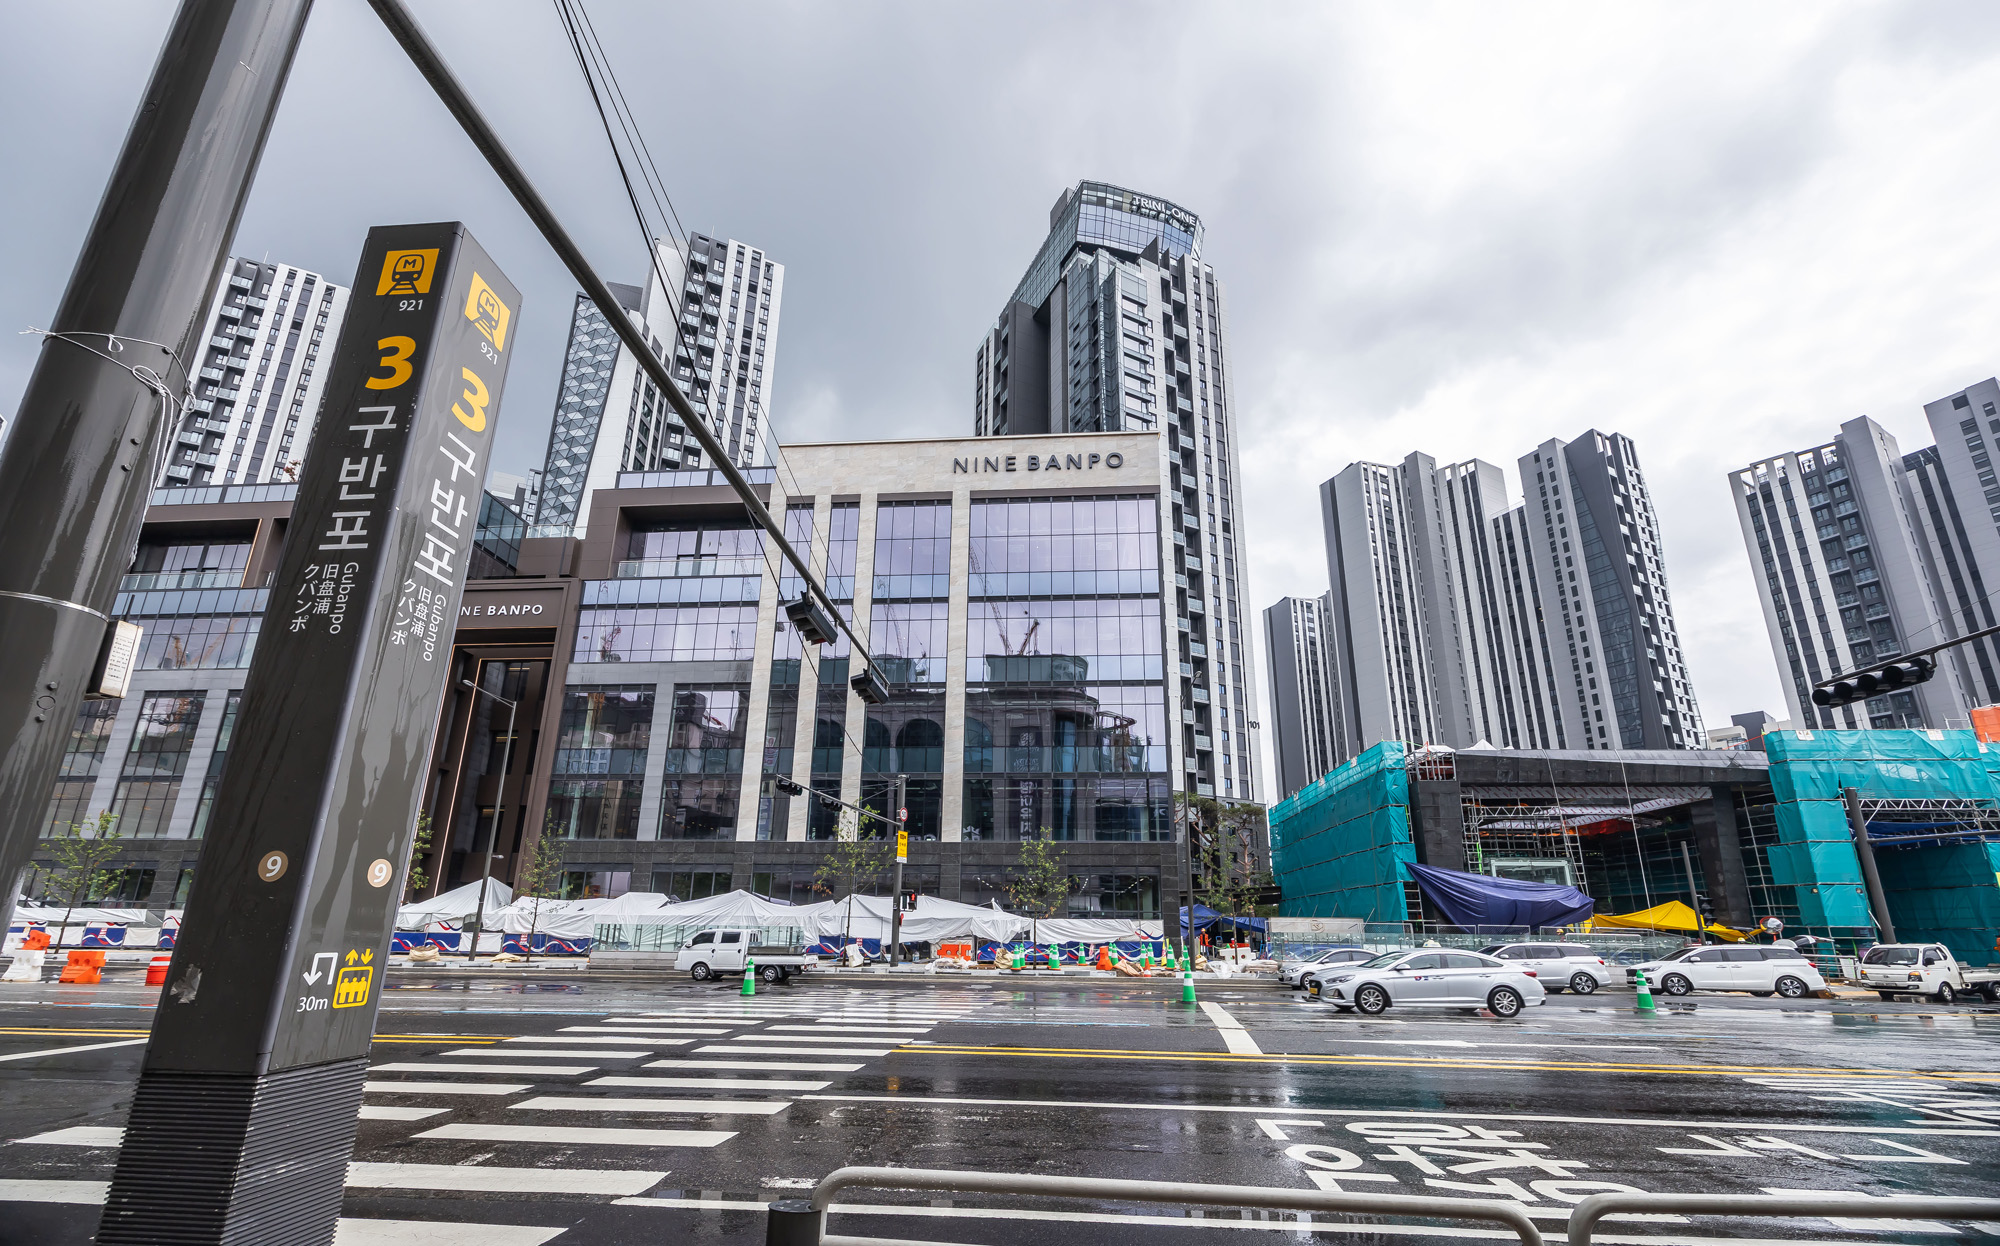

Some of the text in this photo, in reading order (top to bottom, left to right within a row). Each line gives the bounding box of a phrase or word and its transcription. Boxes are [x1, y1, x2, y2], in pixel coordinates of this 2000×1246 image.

[1132, 195, 1196, 226] TRINI ONE
[399, 299, 423, 311] 921
[364, 335, 416, 390] 3
[480, 341, 498, 365] 921
[451, 366, 490, 432] 3
[318, 405, 397, 551] 구반포
[953, 452, 1124, 473] NINE BANPO
[414, 431, 476, 587] 구반포
[289, 563, 319, 633] クバンポ
[329, 562, 359, 634] Gubanpo
[391, 578, 417, 646] クバンポ
[487, 604, 543, 616] BANPO
[422, 594, 447, 662] Gubanpo
[265, 855, 282, 877] 9
[373, 863, 387, 883] 9
[296, 996, 328, 1012] 30m
